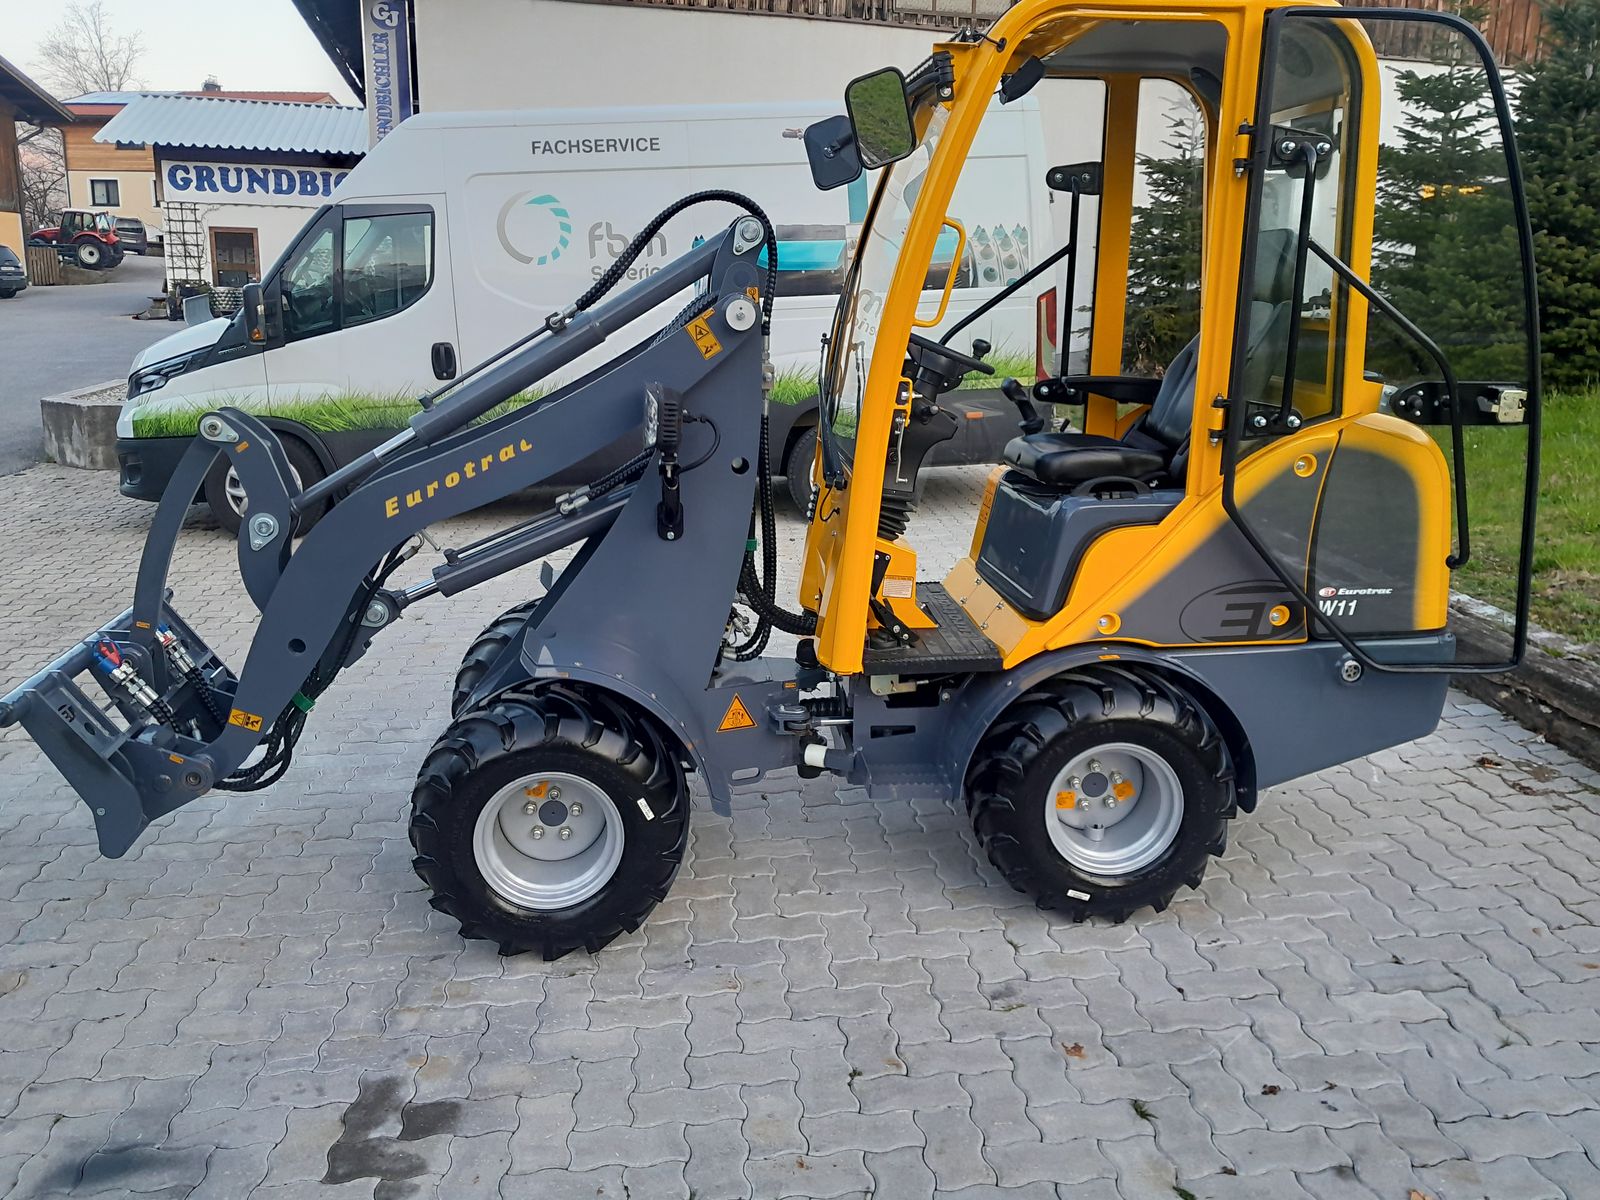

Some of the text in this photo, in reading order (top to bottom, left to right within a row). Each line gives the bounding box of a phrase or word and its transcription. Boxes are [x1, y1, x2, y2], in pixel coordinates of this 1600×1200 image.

[531, 137, 661, 155] FACHSERVICE
[1337, 587, 1393, 596] Eurotrac
[1318, 599, 1358, 617] W11
